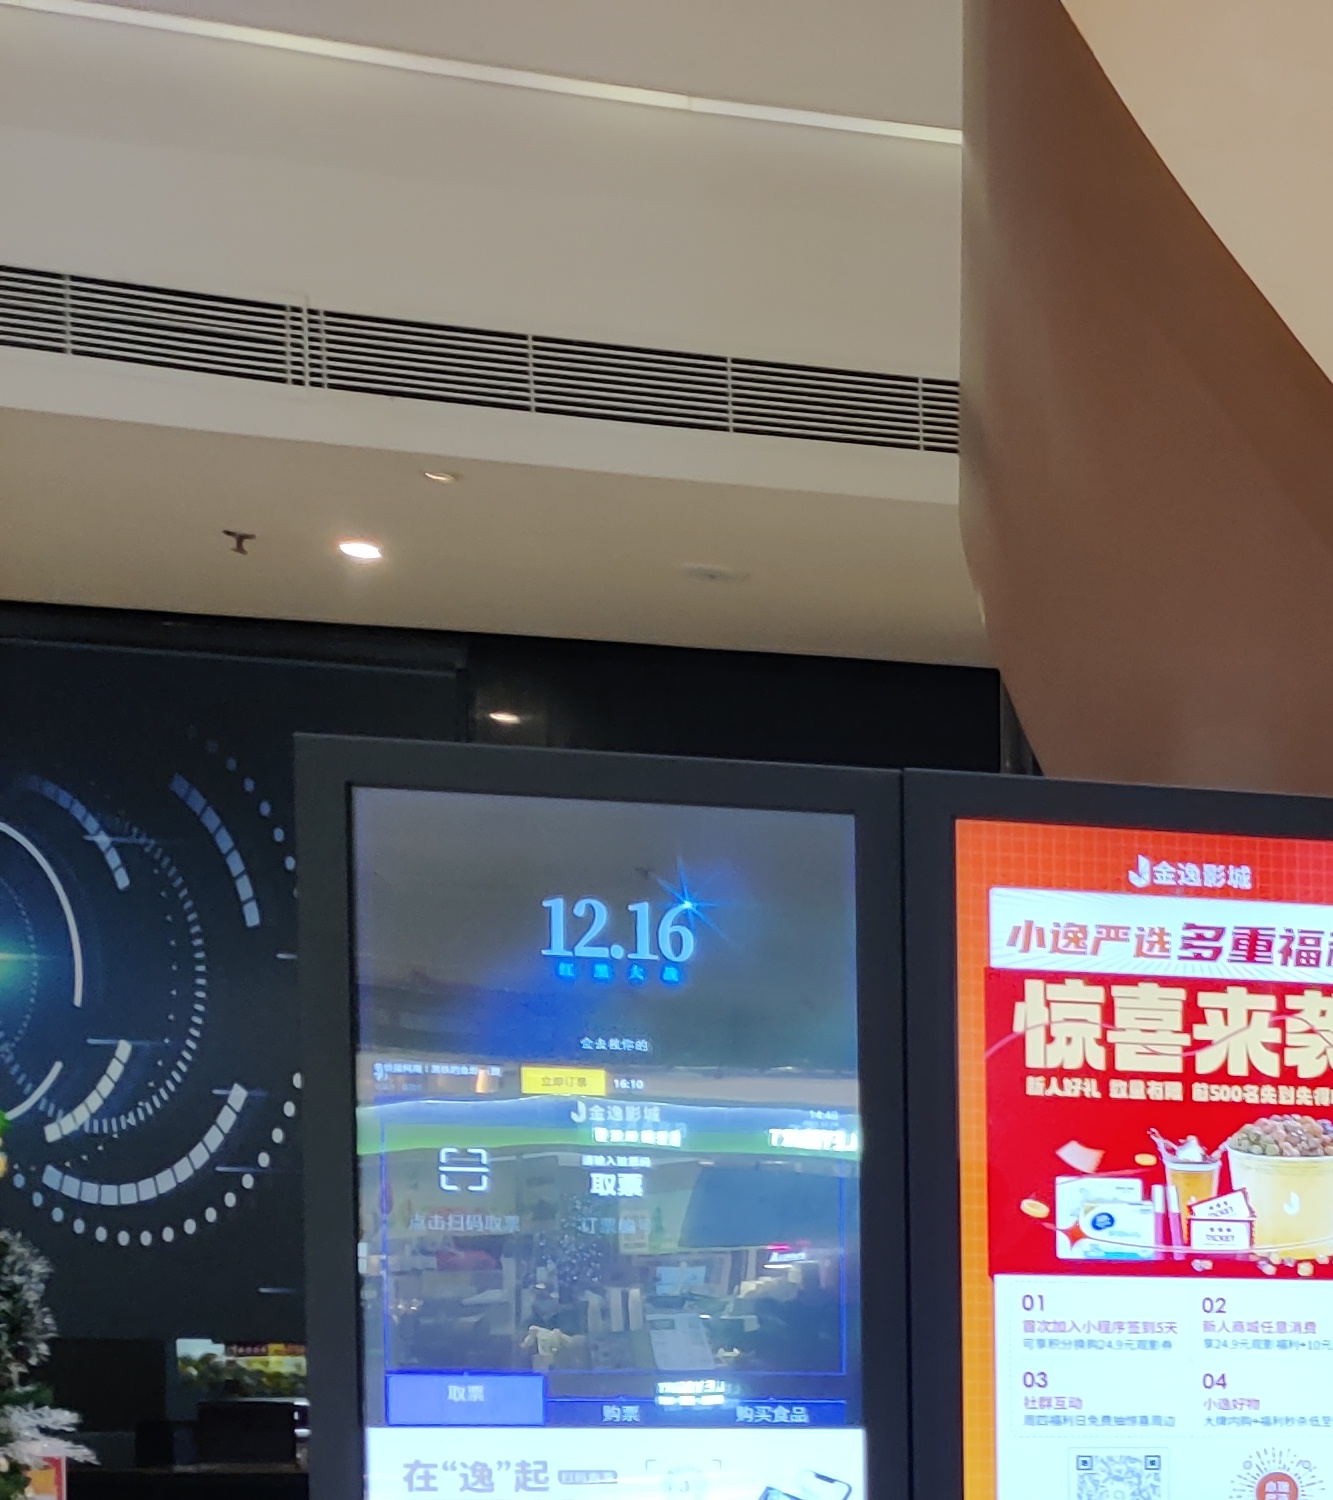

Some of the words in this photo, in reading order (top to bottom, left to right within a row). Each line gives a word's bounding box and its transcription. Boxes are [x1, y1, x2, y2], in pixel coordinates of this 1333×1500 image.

[541, 898, 694, 962] 12.16
[614, 1079, 643, 1090] 16:10
[589, 1105, 660, 1122] 金逸影城
[590, 1173, 643, 1196] 取票
[410, 1215, 520, 1232] 点击扫码取票
[1022, 1294, 1044, 1311] 01
[1202, 1297, 1227, 1313] 02
[1023, 1371, 1048, 1388] 03
[1202, 1373, 1227, 1389] 04
[448, 1385, 484, 1402] 取票
[603, 1405, 641, 1422] 购票
[736, 1406, 809, 1423] 购买食品
